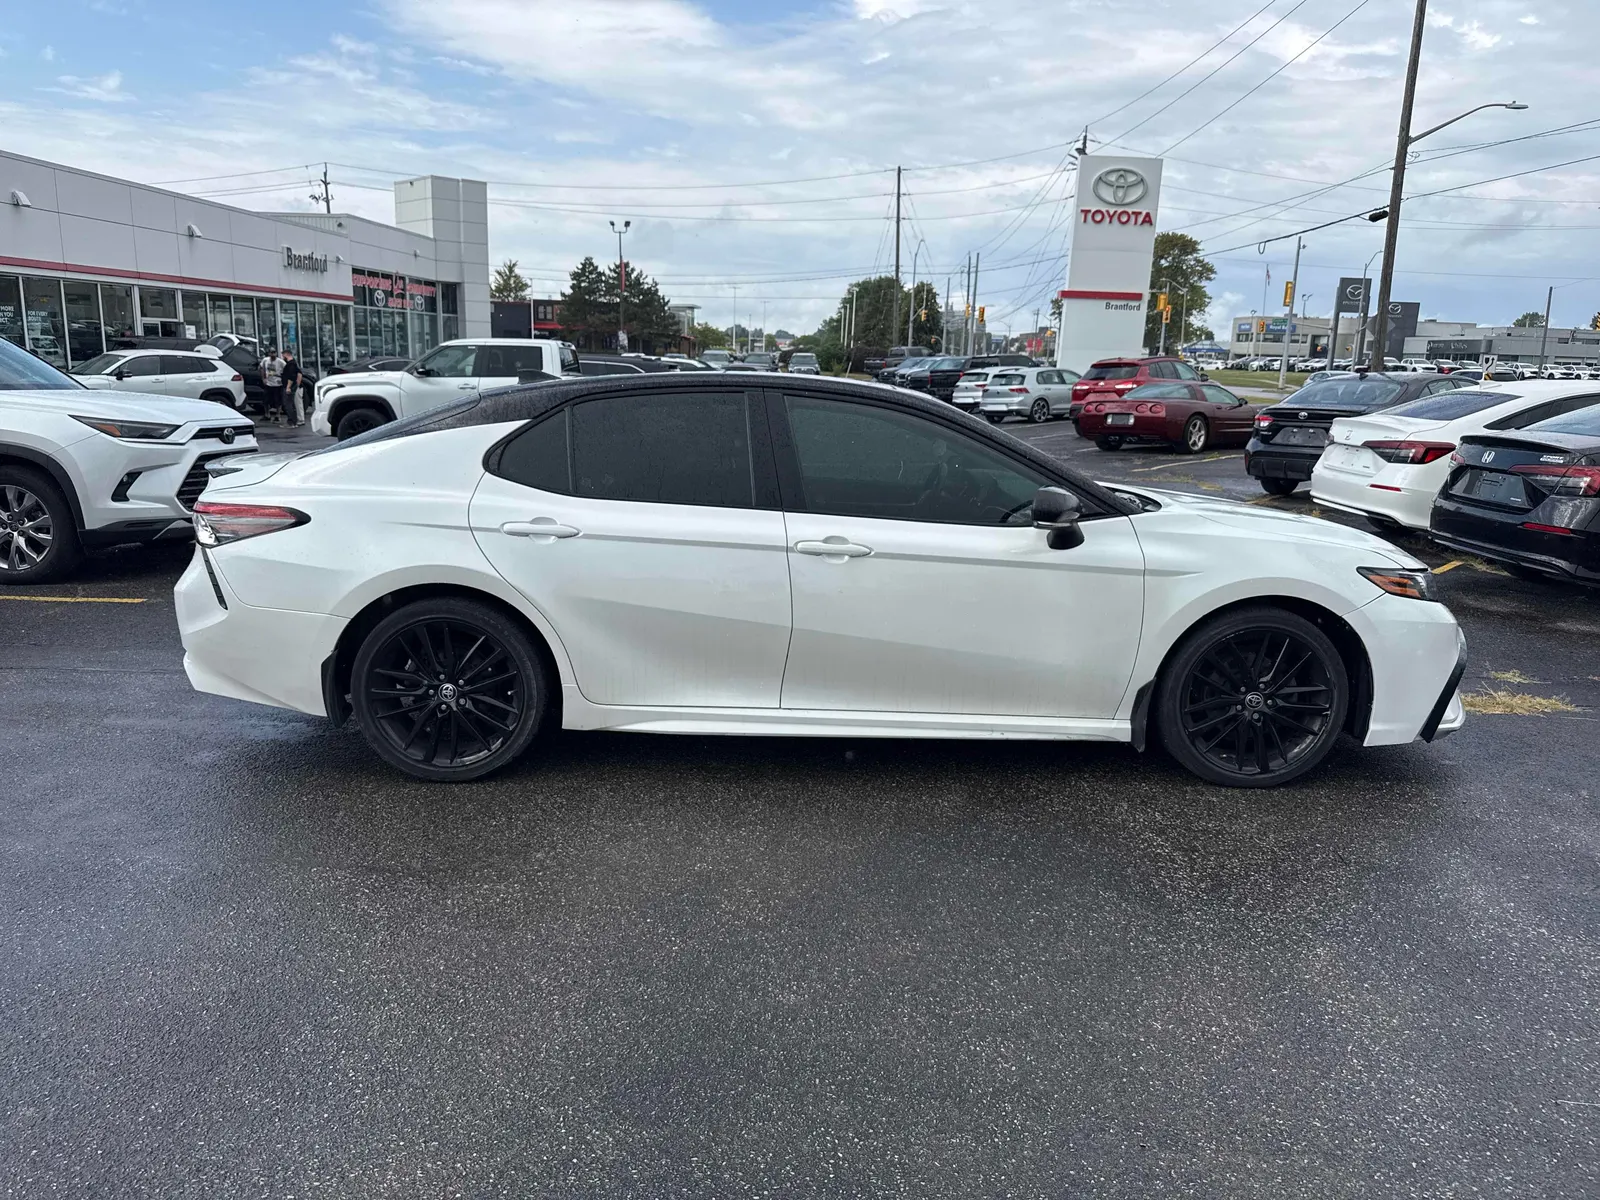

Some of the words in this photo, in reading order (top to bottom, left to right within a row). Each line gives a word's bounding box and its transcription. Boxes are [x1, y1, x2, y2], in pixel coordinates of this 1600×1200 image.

[1080, 209, 1153, 226] TOYOTA
[284, 246, 328, 272] Brantford
[1105, 301, 1141, 312] Brantford
